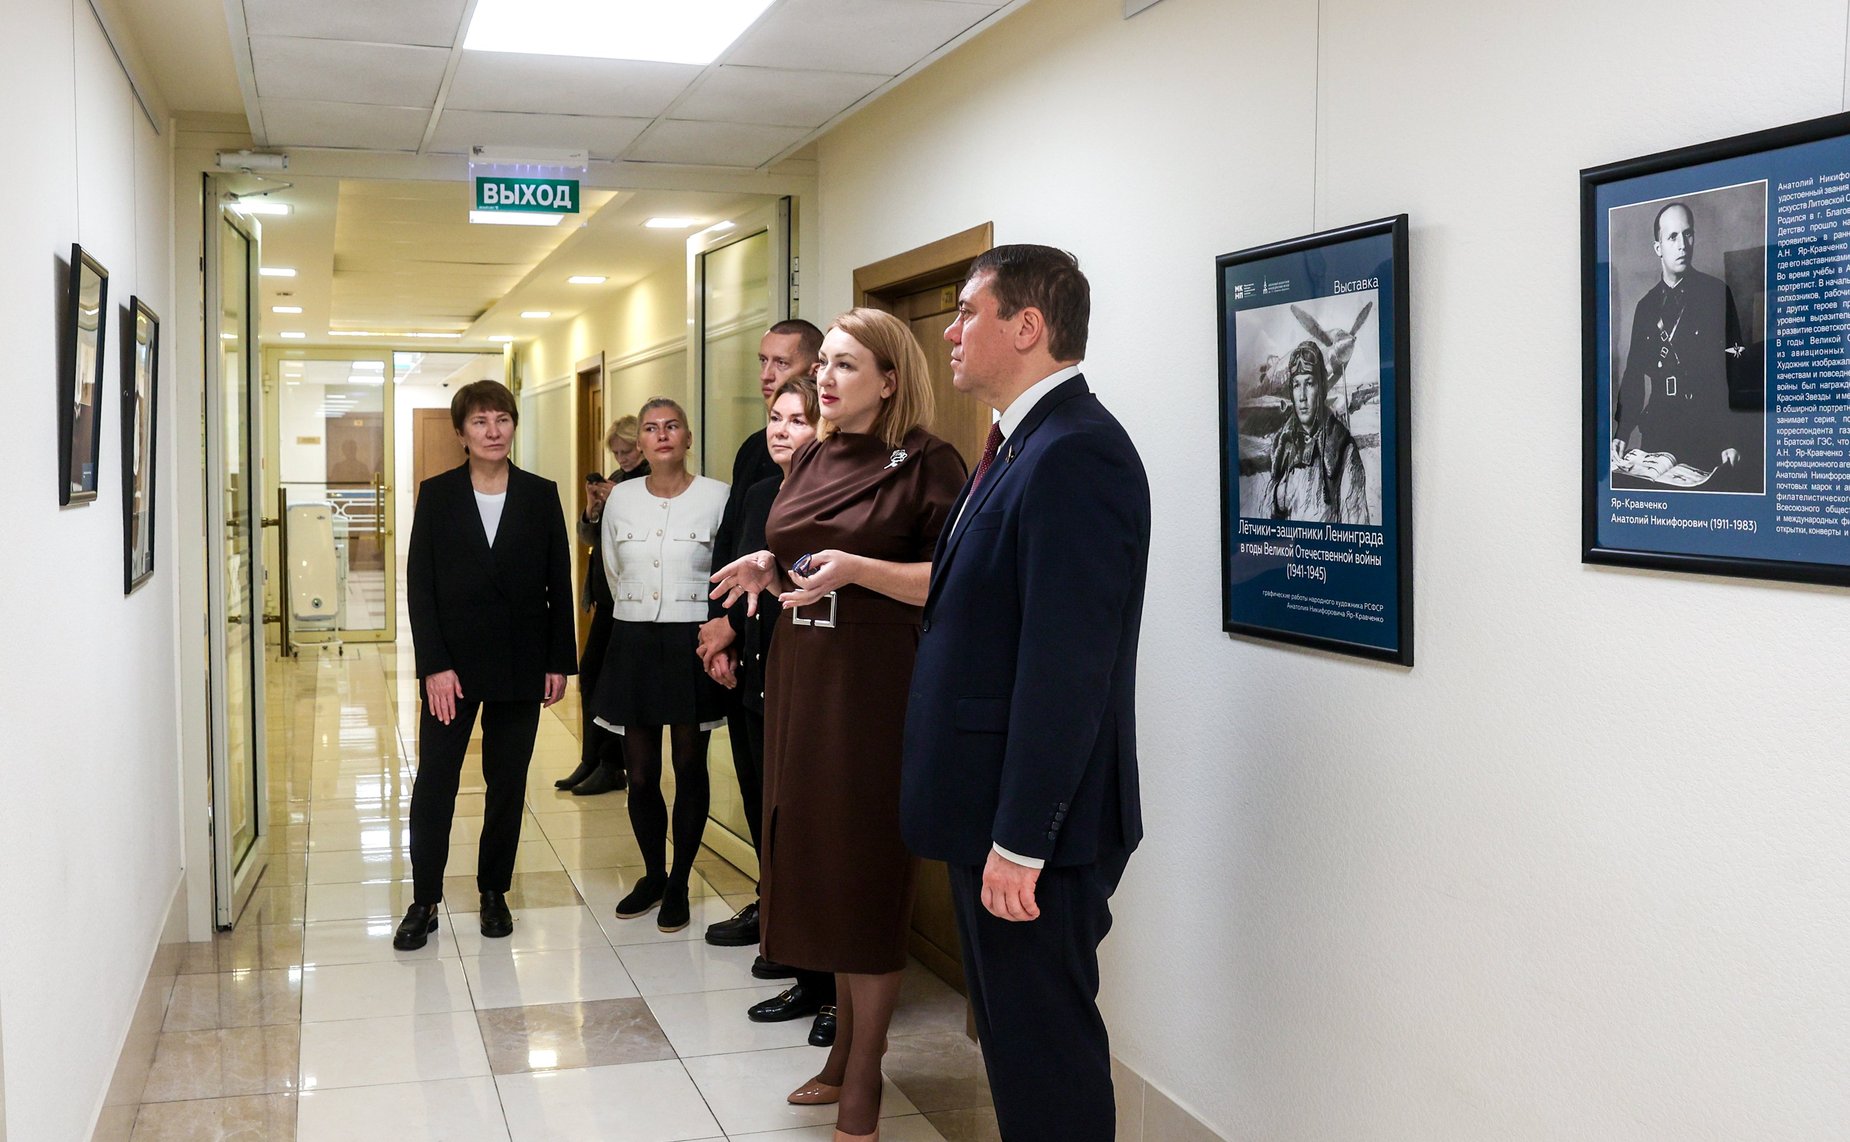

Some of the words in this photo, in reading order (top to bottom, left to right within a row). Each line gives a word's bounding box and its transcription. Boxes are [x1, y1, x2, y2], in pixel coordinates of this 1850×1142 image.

[1778, 178, 1814, 191] Анатолий
[1820, 172, 1850, 183] Никифо
[484, 183, 572, 208] ВЫХОД
[1778, 188, 1823, 203] удостоенный
[1824, 184, 1849, 194] звания
[1778, 203, 1807, 213] искусств
[1808, 195, 1844, 208] Литовской
[1778, 214, 1806, 224] Родился
[1778, 226, 1805, 237] Детство
[1810, 221, 1837, 232] прошло
[1778, 236, 1817, 248] проявились
[1778, 249, 1792, 257] А.Н.
[1798, 243, 1848, 256] Яр-Кравченко
[1790, 260, 1800, 268] его
[1789, 271, 1810, 279] время
[1813, 267, 1834, 278] учёбы
[1334, 277, 1379, 294] Выставка
[1778, 282, 1816, 292] портретист.
[1786, 305, 1809, 314] других
[1814, 302, 1837, 311] героев
[1777, 316, 1805, 326] уровнем
[1782, 326, 1812, 336] развитие
[1777, 339, 1781, 347] В
[1810, 335, 1840, 344] Великой
[1791, 348, 1844, 357] авиационных
[1777, 361, 1809, 370] Художник
[1777, 393, 1804, 402] Красной
[1805, 393, 1831, 401] Звезды
[1783, 405, 1816, 413] обширной
[1814, 416, 1836, 424] серия,
[1784, 438, 1814, 446] Братской
[1818, 437, 1834, 446] ГЭС,
[1796, 449, 1843, 458] Яр-Кравченко
[1777, 460, 1838, 468] информационного
[1811, 484, 1832, 492] марок
[1611, 498, 1667, 510] Яр-Кравченко
[1777, 503, 1820, 512] Всесоюзного
[1611, 513, 1648, 525] Анатолий
[1650, 515, 1708, 529] Никифорович
[1710, 518, 1757, 533] (1911-1983)
[1783, 516, 1838, 524] международных
[1325, 525, 1383, 547] Ленинграда
[1776, 526, 1807, 534] открытки,
[1809, 528, 1840, 536] конверты
[1241, 543, 1244, 552] в
[1246, 544, 1262, 554] годы
[1264, 542, 1293, 557] Великой
[1295, 545, 1353, 563] Отечественной
[1356, 551, 1381, 566] войны
[1287, 563, 1326, 584] (1941-1945)
[1263, 590, 1290, 600] графические
[1291, 594, 1307, 602] работы
[1309, 596, 1335, 607] народного
[1336, 599, 1363, 610] художника
[1364, 602, 1383, 612] РСФСР
[1287, 603, 1308, 612] Анатолия
[1310, 606, 1345, 617] Никифоровича
[1346, 610, 1384, 623] Яр-Кравченко
